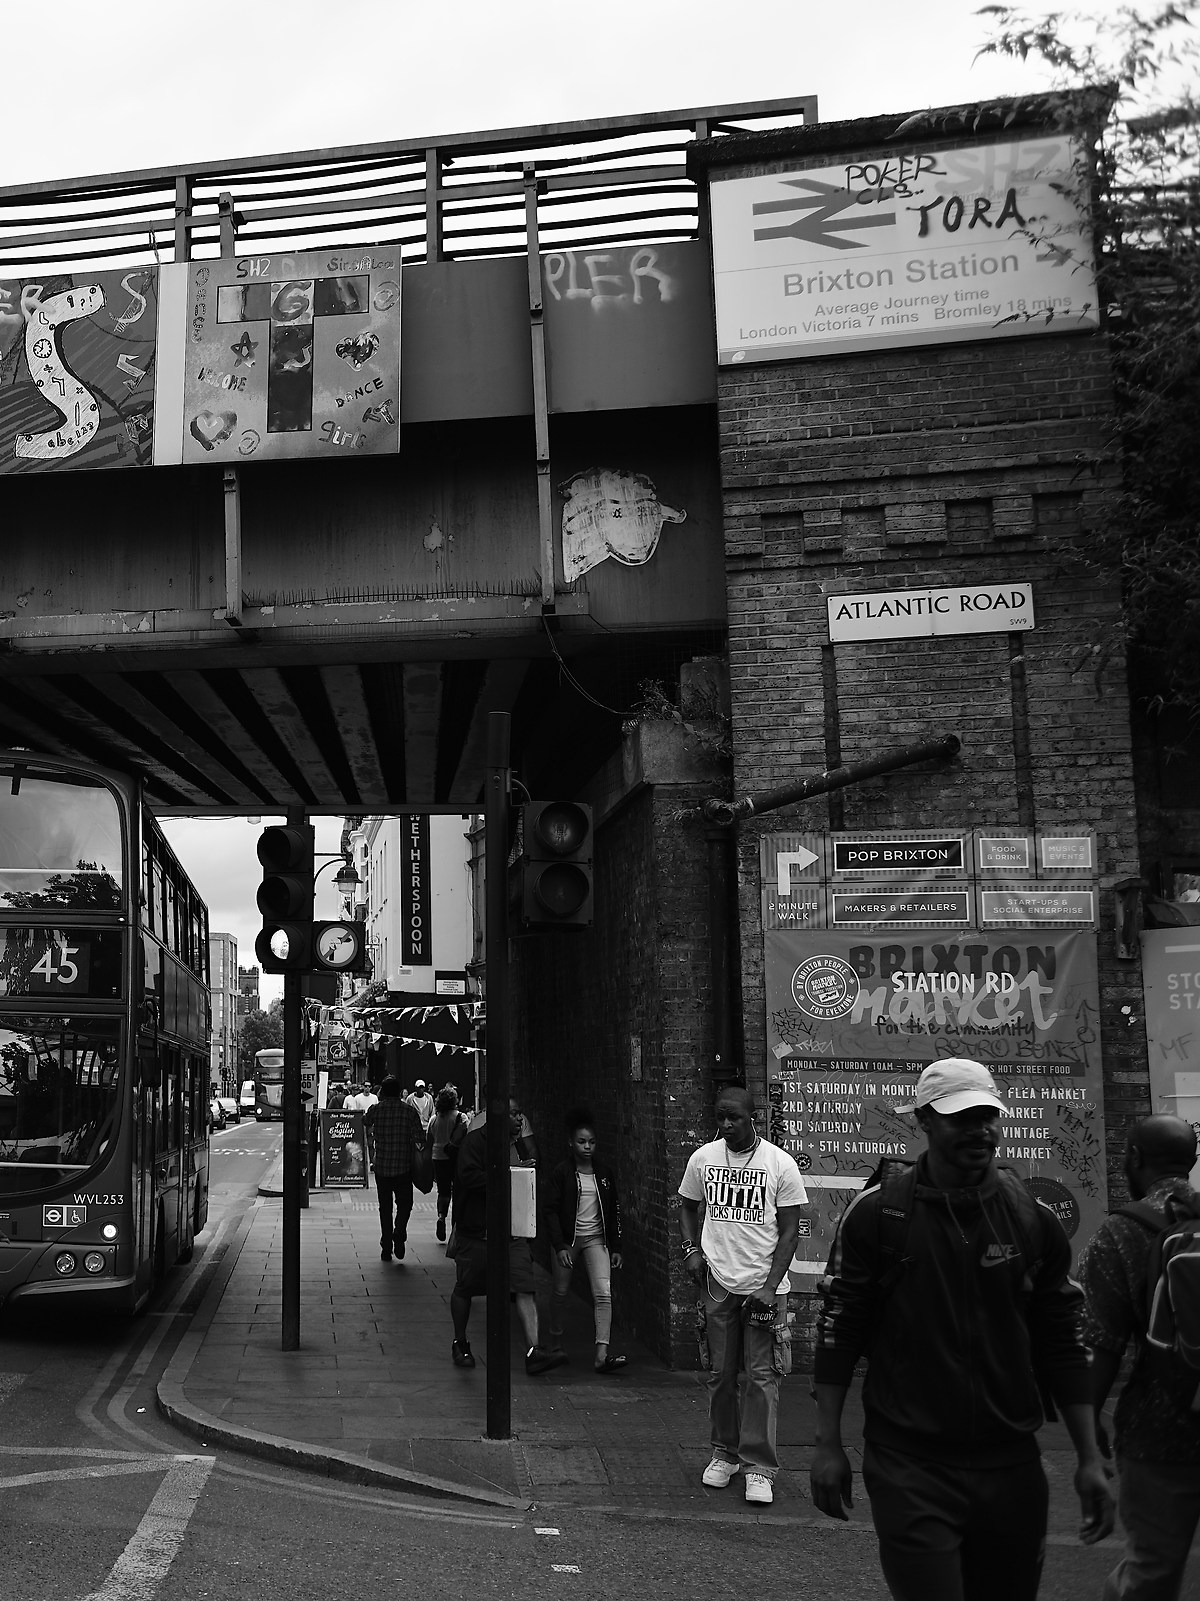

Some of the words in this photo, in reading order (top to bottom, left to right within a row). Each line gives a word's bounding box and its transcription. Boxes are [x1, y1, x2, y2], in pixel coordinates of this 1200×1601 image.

[236, 258, 271, 278] SW2
[783, 265, 894, 297] Brixton
[906, 251, 1019, 284] Station
[814, 299, 880, 317] Average
[884, 293, 949, 311] Journey
[954, 288, 990, 302] time
[739, 325, 798, 341] London
[802, 315, 862, 334] Victoria
[866, 315, 876, 327] 7
[881, 312, 919, 326] mins
[934, 302, 1001, 321] Bromley
[1007, 299, 1026, 313] 18
[1031, 295, 1072, 310] mins
[836, 595, 950, 620] ATLANTIC
[960, 591, 1026, 612] ROAD
[1009, 617, 1027, 626] SW9
[849, 850, 879, 862] POP
[883, 849, 949, 861] BRIXTON
[1048, 845, 1075, 853] MUSIC
[995, 853, 1022, 861] DRINK
[1049, 853, 1085, 861] EVENTS
[778, 902, 818, 911] MINUTE
[844, 904, 886, 913] MAKERS
[890, 904, 897, 912] &
[900, 903, 957, 912] RETAILERS
[993, 907, 1026, 915] SOCIAL
[1028, 906, 1084, 915] ENTERPRISE
[777, 912, 810, 921] WALK
[30, 947, 79, 984] 45
[798, 959, 822, 980] BRIXTON
[824, 959, 849, 975] PEOPLE
[850, 944, 1058, 981] BRIXTON
[891, 971, 976, 994] STATION
[985, 971, 1016, 994] RD
[810, 1004, 824, 1016] FOR
[825, 993, 855, 1016] EVERYONE
[875, 1015, 899, 1036] for
[787, 1060, 818, 1069] MONDAY
[830, 1061, 869, 1071] SATURDAY
[873, 1062, 893, 1071] 10AM
[906, 1062, 923, 1072] 5PM
[998, 1065, 1013, 1074] HOT
[1016, 1065, 1047, 1074] STREET
[1050, 1065, 1071, 1075] FOOD
[783, 1082, 801, 1094] 1ST
[806, 1083, 861, 1096] SATURDAY
[865, 1084, 876, 1096] IN
[882, 1084, 917, 1097] MONTH
[1007, 1087, 1035, 1100] FLEA
[1041, 1087, 1086, 1101] MARKET
[783, 1101, 803, 1113] 2ND
[807, 1102, 862, 1115] SATURDAY
[783, 1120, 803, 1132] 3RD
[807, 1121, 862, 1134] SATURDAY
[1002, 1126, 1050, 1139] VINTAGE
[783, 1140, 803, 1151] 4TH
[819, 1140, 840, 1152] 5TH
[844, 1141, 907, 1155] SATURDAYS
[1006, 1147, 1051, 1160] MARKET
[707, 1167, 766, 1188] STRAIGHT
[73, 1193, 124, 1205] WVL253
[706, 1182, 763, 1210] OUTTA
[731, 1207, 741, 1221] TO
[743, 1209, 763, 1223] GIVE
[986, 1243, 1014, 1257] NIKE
